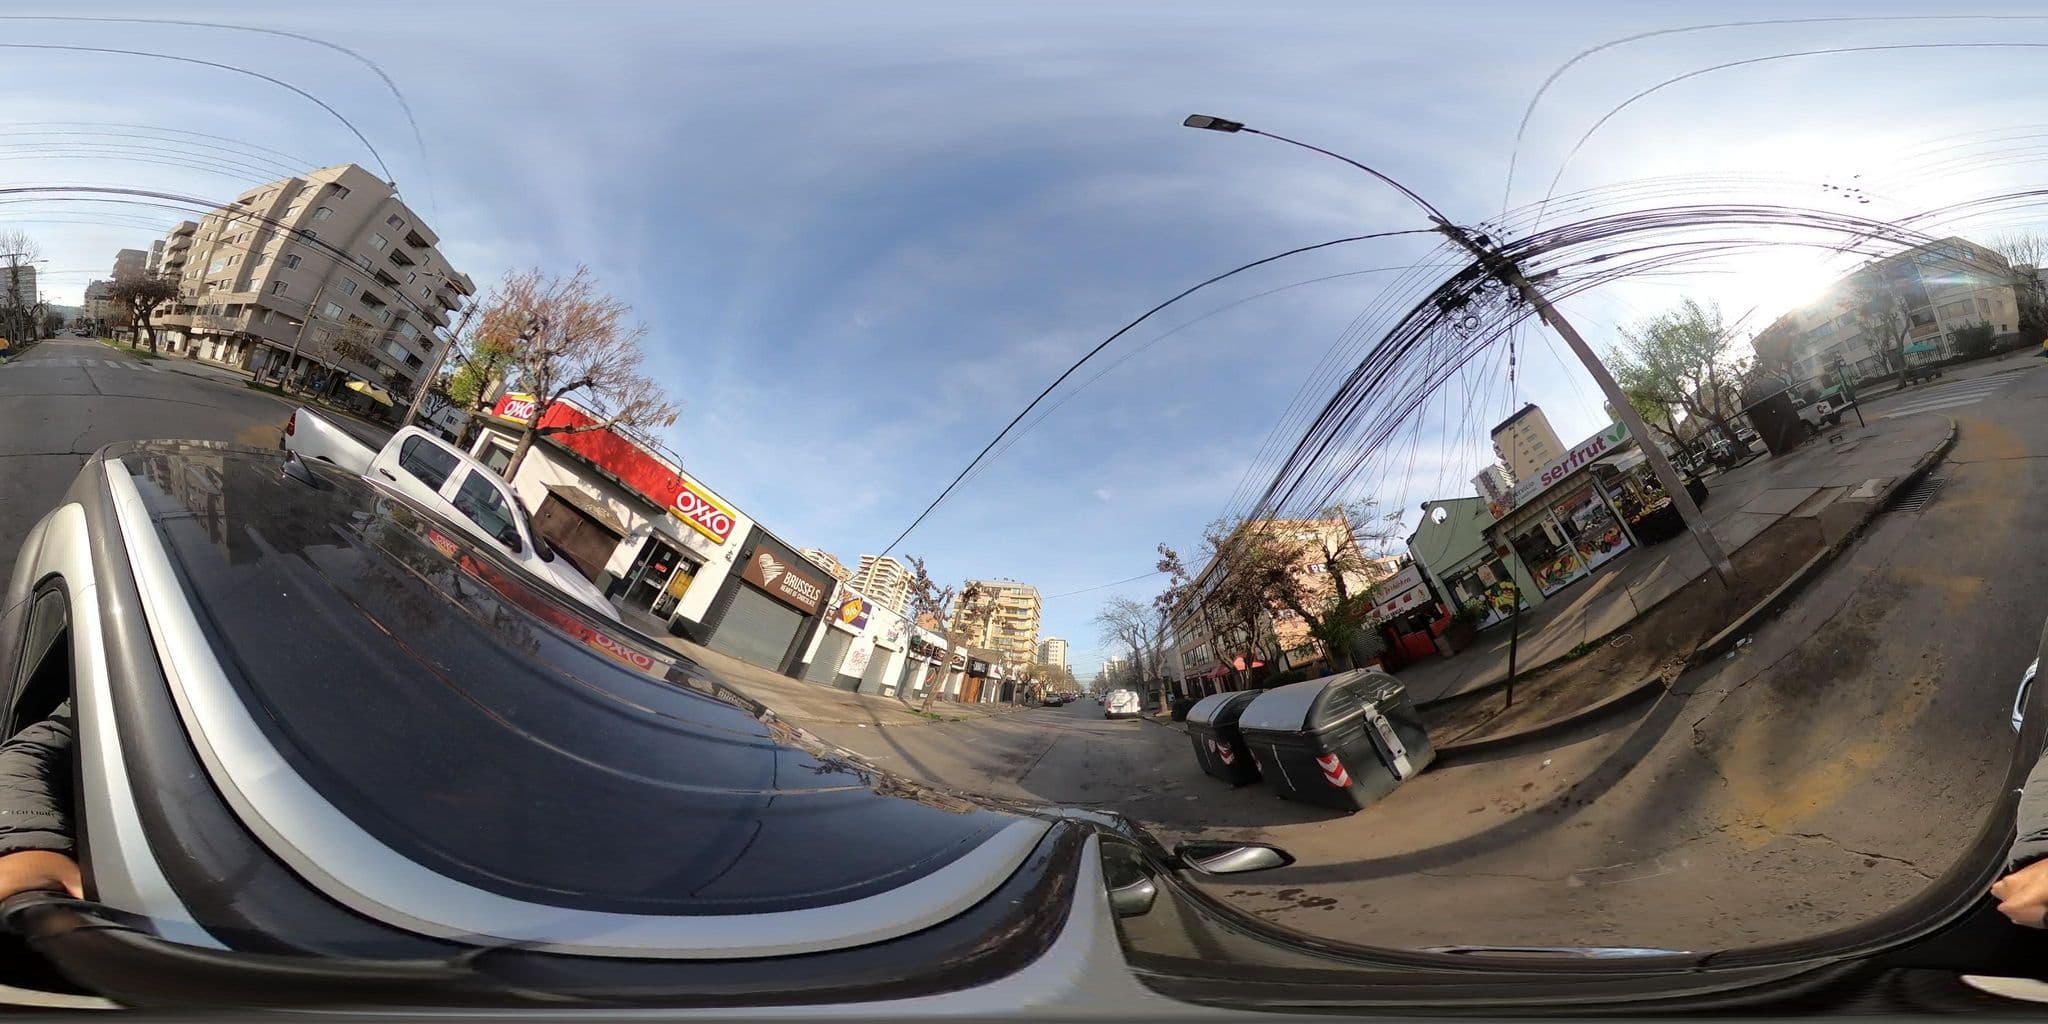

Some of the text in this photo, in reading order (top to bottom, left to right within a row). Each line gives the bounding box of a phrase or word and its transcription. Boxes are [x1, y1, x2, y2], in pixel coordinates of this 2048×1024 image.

[504, 401, 534, 418] OXXO
[1541, 436, 1607, 487] serfrut
[676, 491, 730, 535] OXXO
[779, 584, 794, 595] HEART
[783, 571, 821, 601] BRUSSELS
